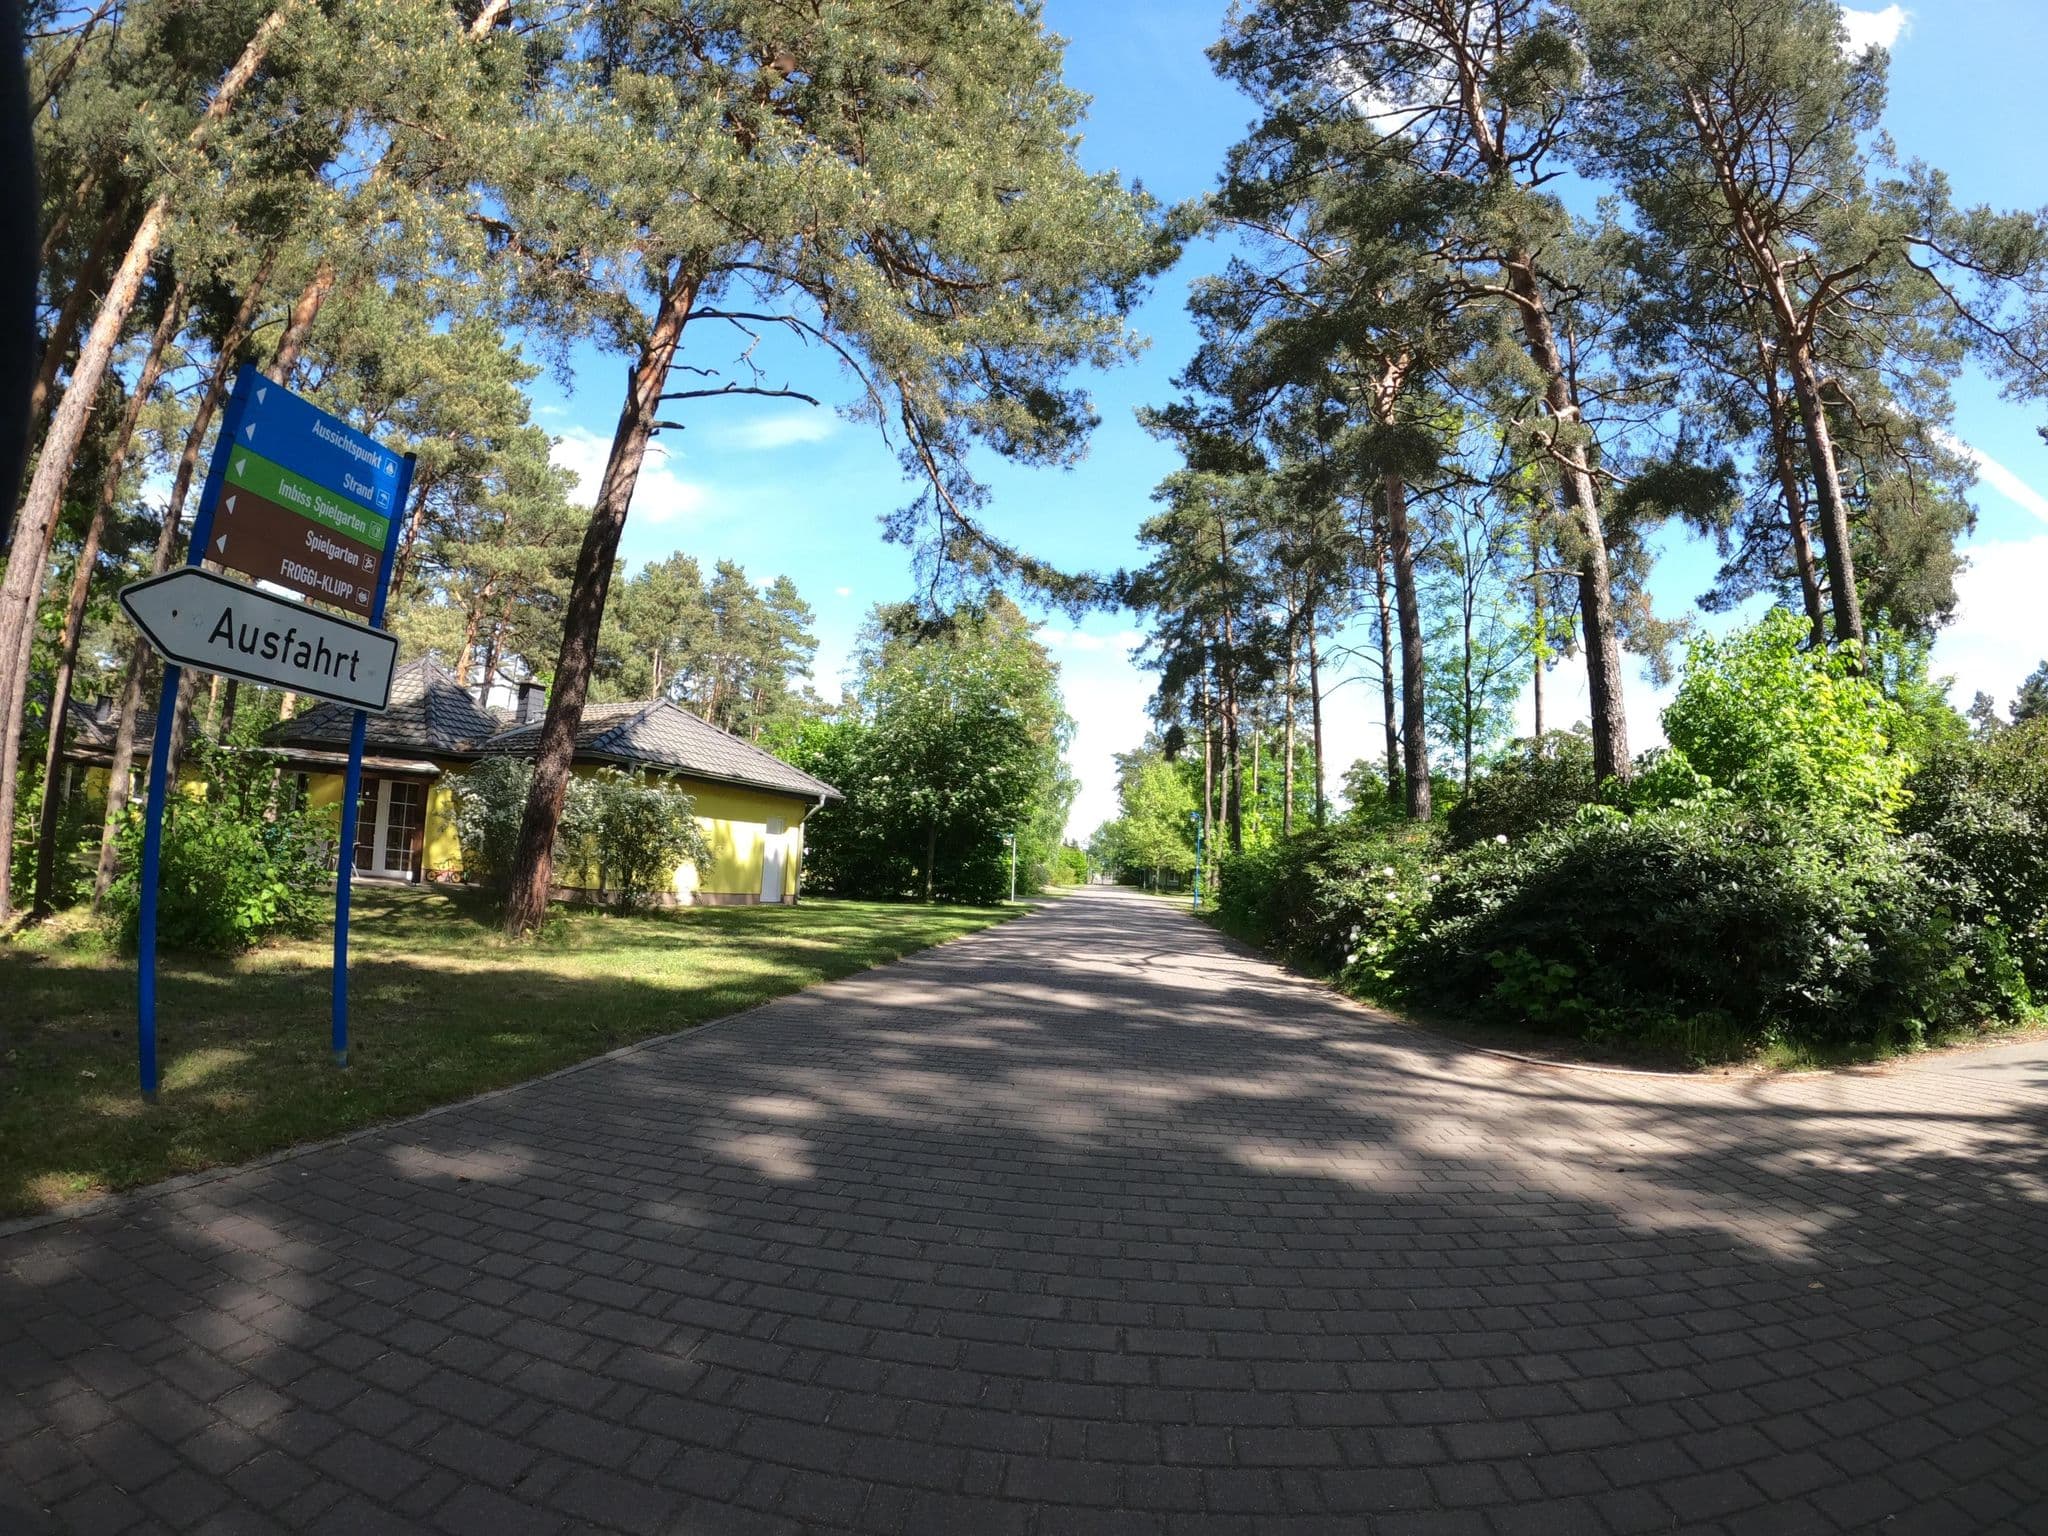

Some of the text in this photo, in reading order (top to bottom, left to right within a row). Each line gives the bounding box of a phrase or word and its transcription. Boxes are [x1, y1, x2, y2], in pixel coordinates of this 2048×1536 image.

[312, 419, 382, 469] Aussichtspunkt
[279, 478, 366, 533] Imbiss Spielgarten
[343, 473, 374, 501] Strand
[305, 530, 359, 567] Spielgarten
[280, 558, 353, 599] FROGGI-KLUPP
[207, 606, 360, 682] Ausfahrt
